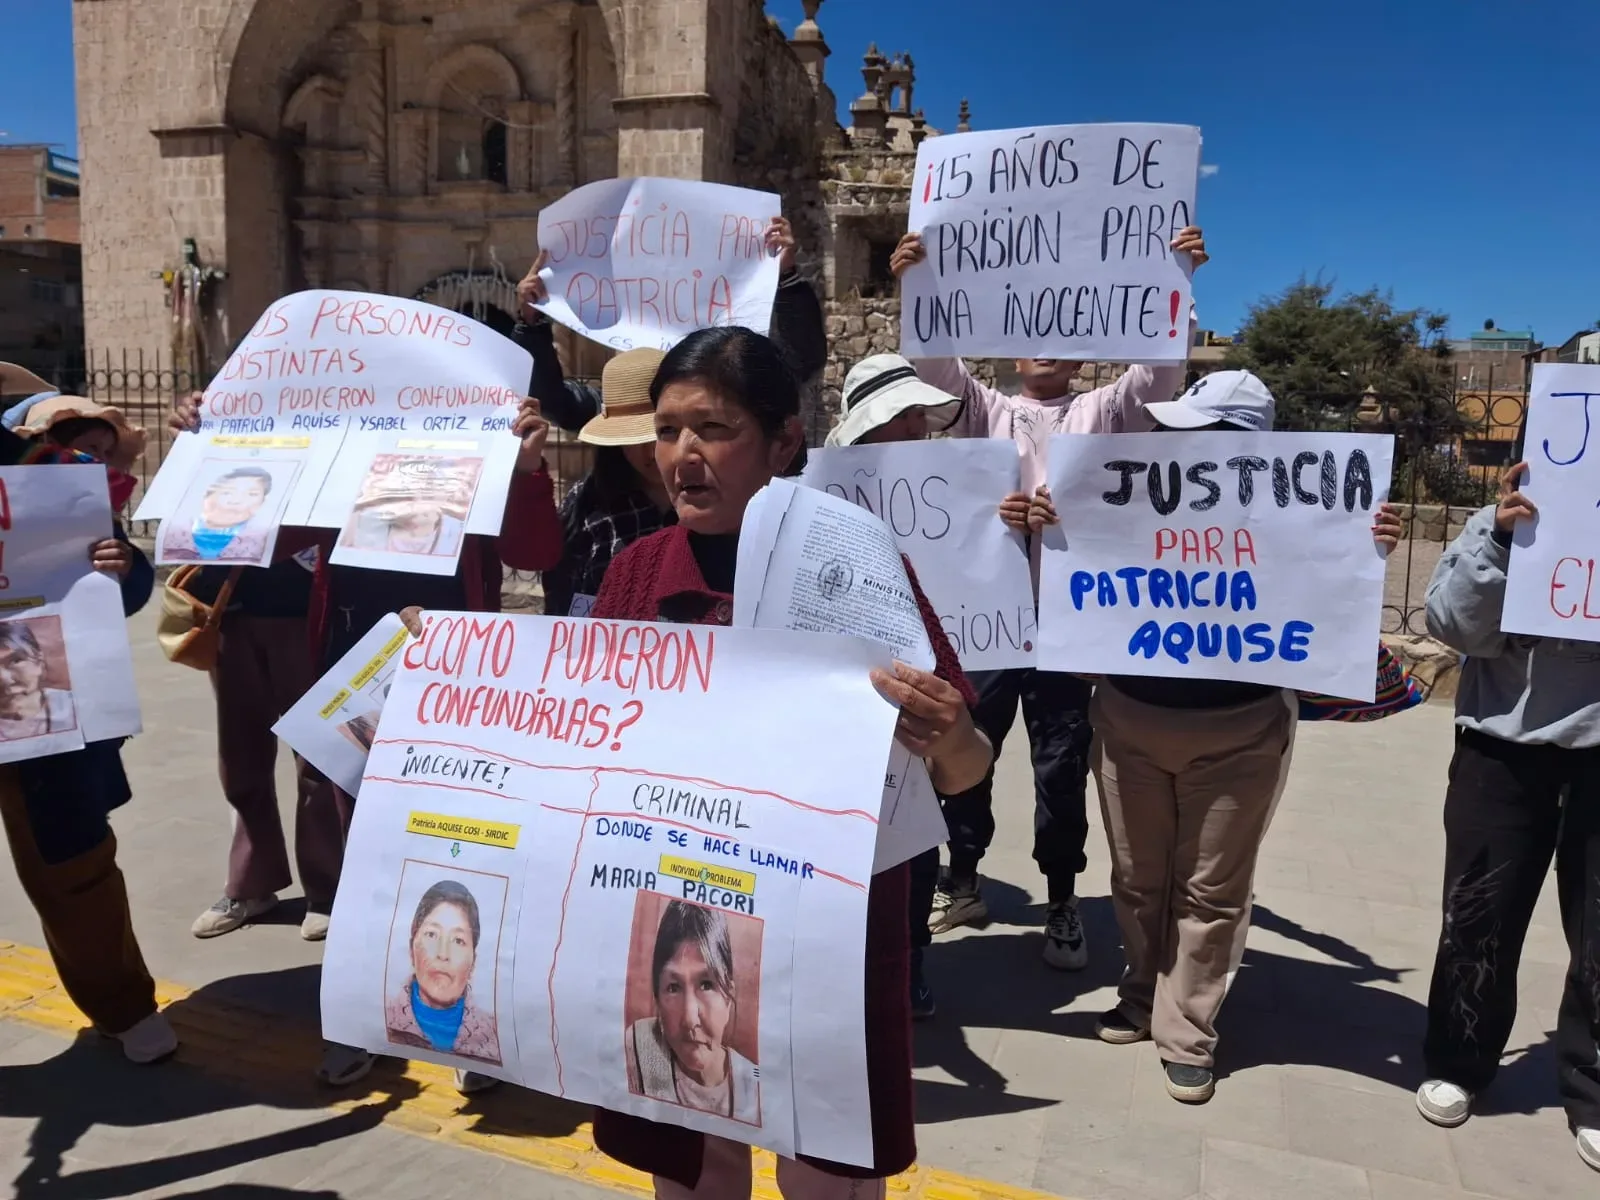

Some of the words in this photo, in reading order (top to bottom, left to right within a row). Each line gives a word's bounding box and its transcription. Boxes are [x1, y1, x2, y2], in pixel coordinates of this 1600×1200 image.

[990, 133, 1078, 194] AÑOS
[1113, 137, 1164, 189] DE
[547, 200, 690, 264] JUSTICIA
[939, 206, 1061, 277] PRISION
[1101, 200, 1189, 261] PARA
[310, 297, 473, 347] PERSONAS
[566, 269, 733, 328] PATRICIA
[914, 288, 973, 343] UNA
[219, 416, 275, 434] PATRICIA
[291, 412, 342, 432] AQUISE
[278, 384, 376, 416] PUDIERON
[359, 416, 407, 432] YSABEL
[423, 413, 470, 431] ORTIZ
[481, 417, 513, 431] BRAV
[1102, 448, 1374, 516] JUSTICIA
[1155, 526, 1257, 567] PARA
[1070, 566, 1257, 612] PATRICIA
[404, 616, 517, 679] ¿COMO
[541, 620, 714, 694] PUDIERON
[1128, 619, 1315, 665] AQUISE
[416, 682, 644, 752] CONFUNDIRLAS?
[412, 817, 437, 831] Patricia
[437, 820, 463, 834] AQUISE
[463, 823, 480, 836] COSI
[633, 783, 751, 829] CRIMINAL
[596, 817, 653, 842] DONDE
[668, 829, 688, 848] SE
[703, 837, 741, 857] HACE
[749, 848, 815, 880] LLAMAR
[590, 864, 657, 891] MARIA
